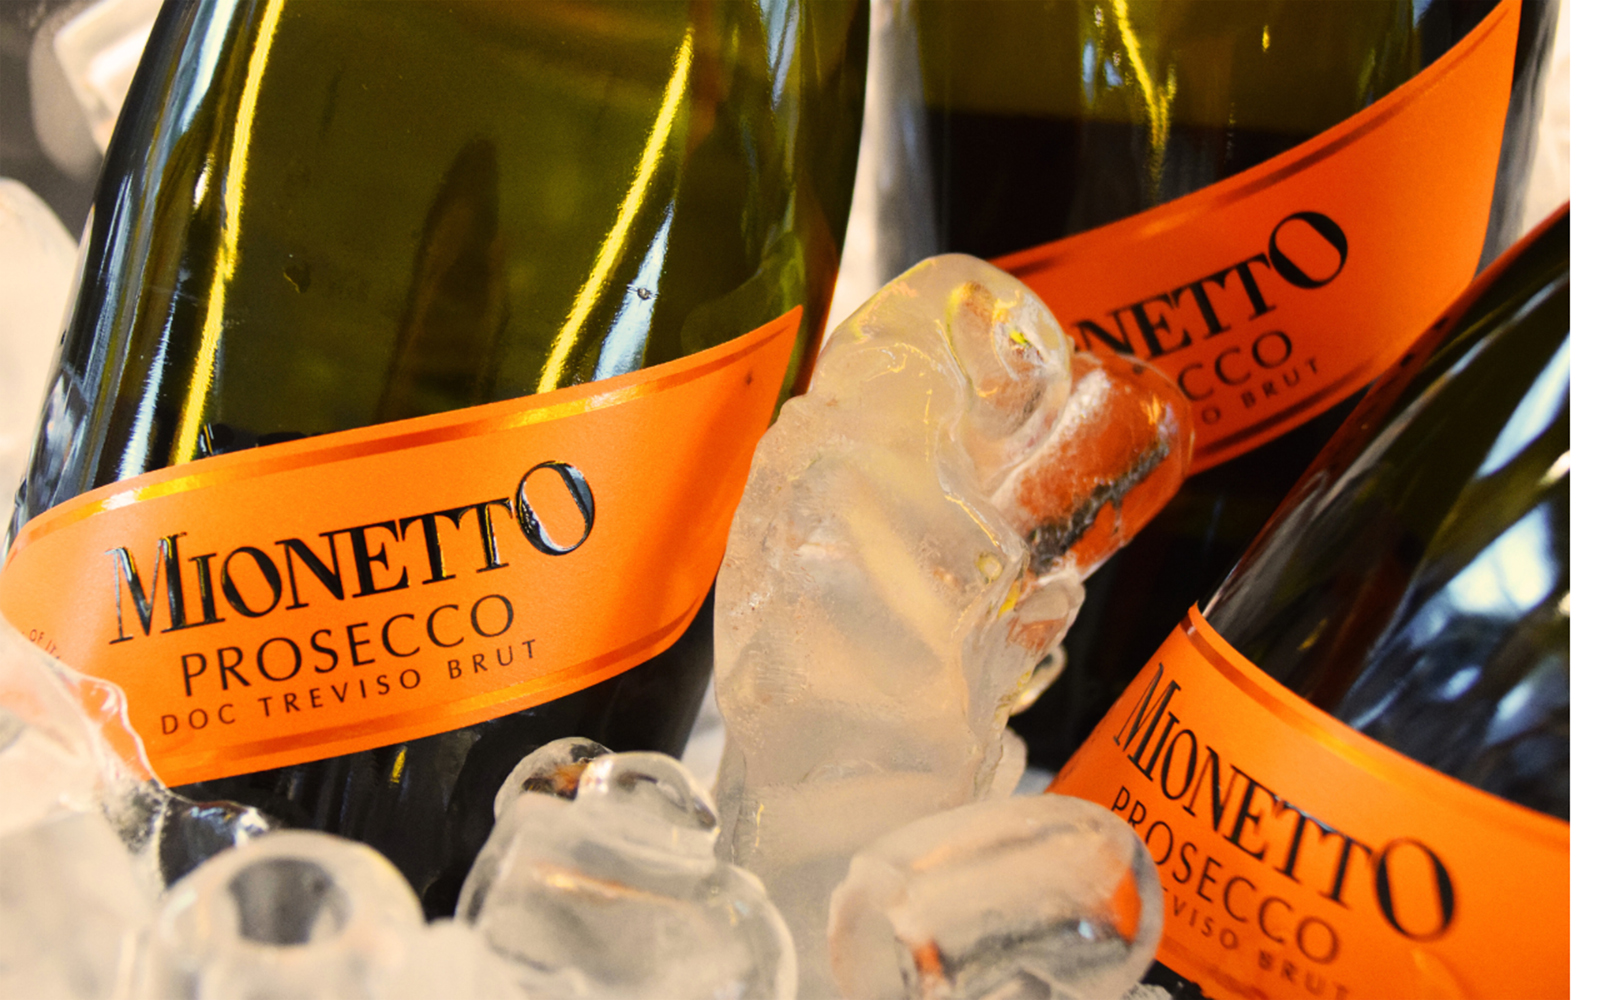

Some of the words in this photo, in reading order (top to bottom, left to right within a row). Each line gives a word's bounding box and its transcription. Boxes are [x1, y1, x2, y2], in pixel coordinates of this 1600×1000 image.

[1071, 211, 1348, 360] NETTO
[1240, 355, 1319, 409] BRUT
[105, 460, 596, 645] MIONETTO
[160, 703, 237, 735] DOC
[257, 668, 422, 719] TREVISO
[447, 638, 538, 680] BRUT
[180, 593, 515, 697] PROSECCO
[1113, 662, 1456, 942] MIONETTO
[1111, 785, 1340, 965] PROSECCO
[1165, 887, 1239, 950] VISO
